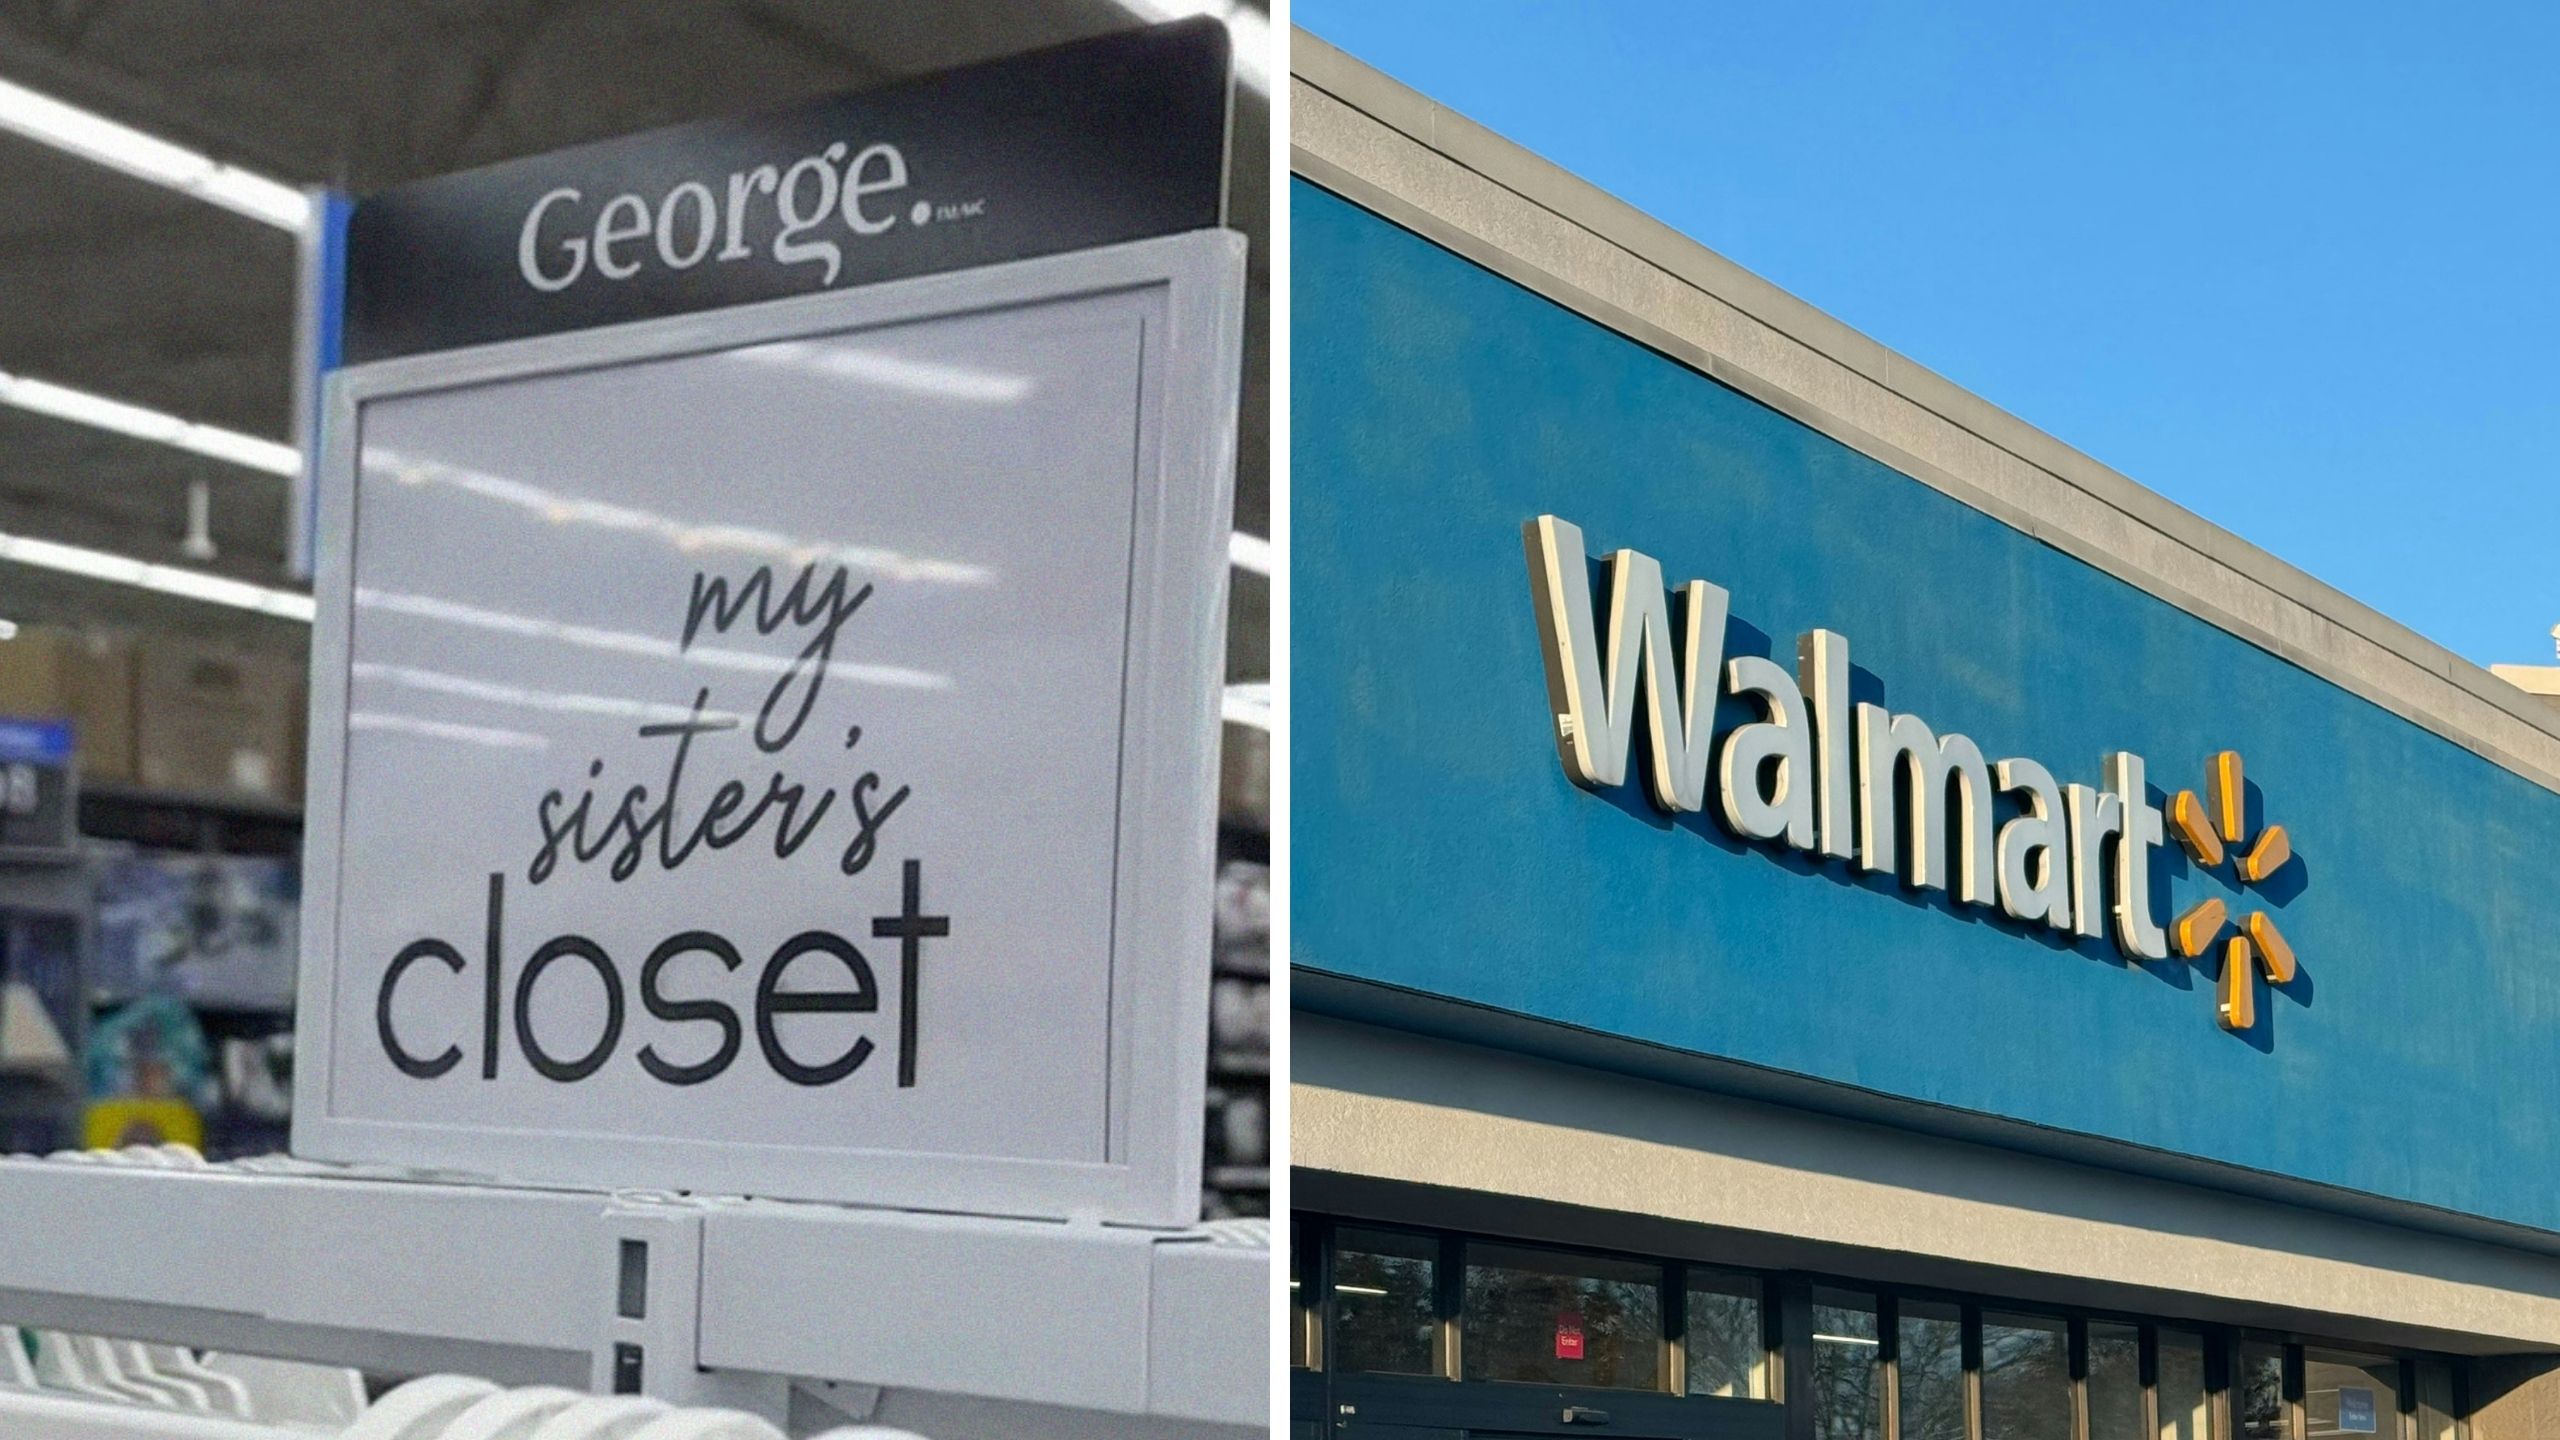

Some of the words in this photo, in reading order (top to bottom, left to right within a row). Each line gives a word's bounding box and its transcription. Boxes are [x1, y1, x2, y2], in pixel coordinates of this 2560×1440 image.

[680, 563, 874, 752] my
[1523, 514, 2168, 960] Walmart
[528, 687, 911, 884] sister's
[377, 859, 950, 1088] closet
